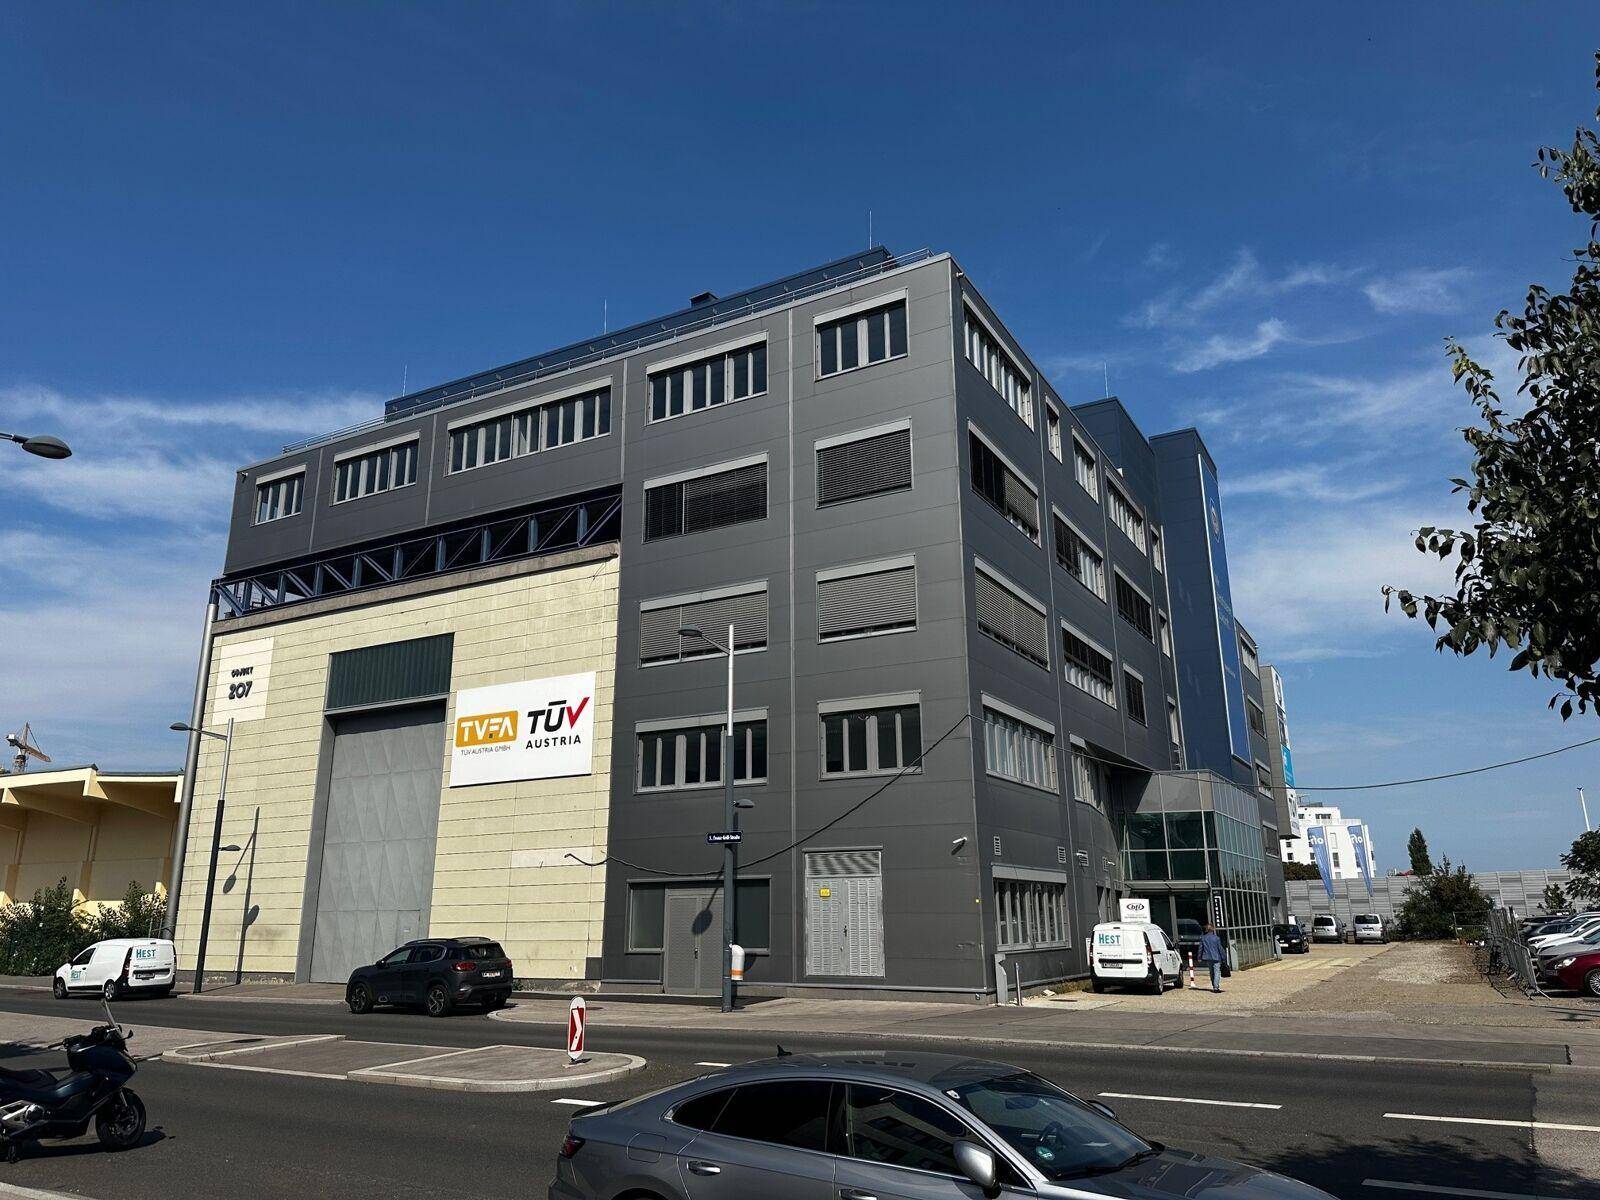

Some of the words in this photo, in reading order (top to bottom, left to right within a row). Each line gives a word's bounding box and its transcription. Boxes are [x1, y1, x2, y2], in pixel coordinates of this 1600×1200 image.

[228, 680, 253, 700] 207
[460, 716, 514, 742] TVFA
[525, 734, 581, 750] AUSTRIA
[471, 746, 493, 755] AUSTRIA
[1098, 933, 1121, 945] HEST
[136, 949, 156, 958] HEST
